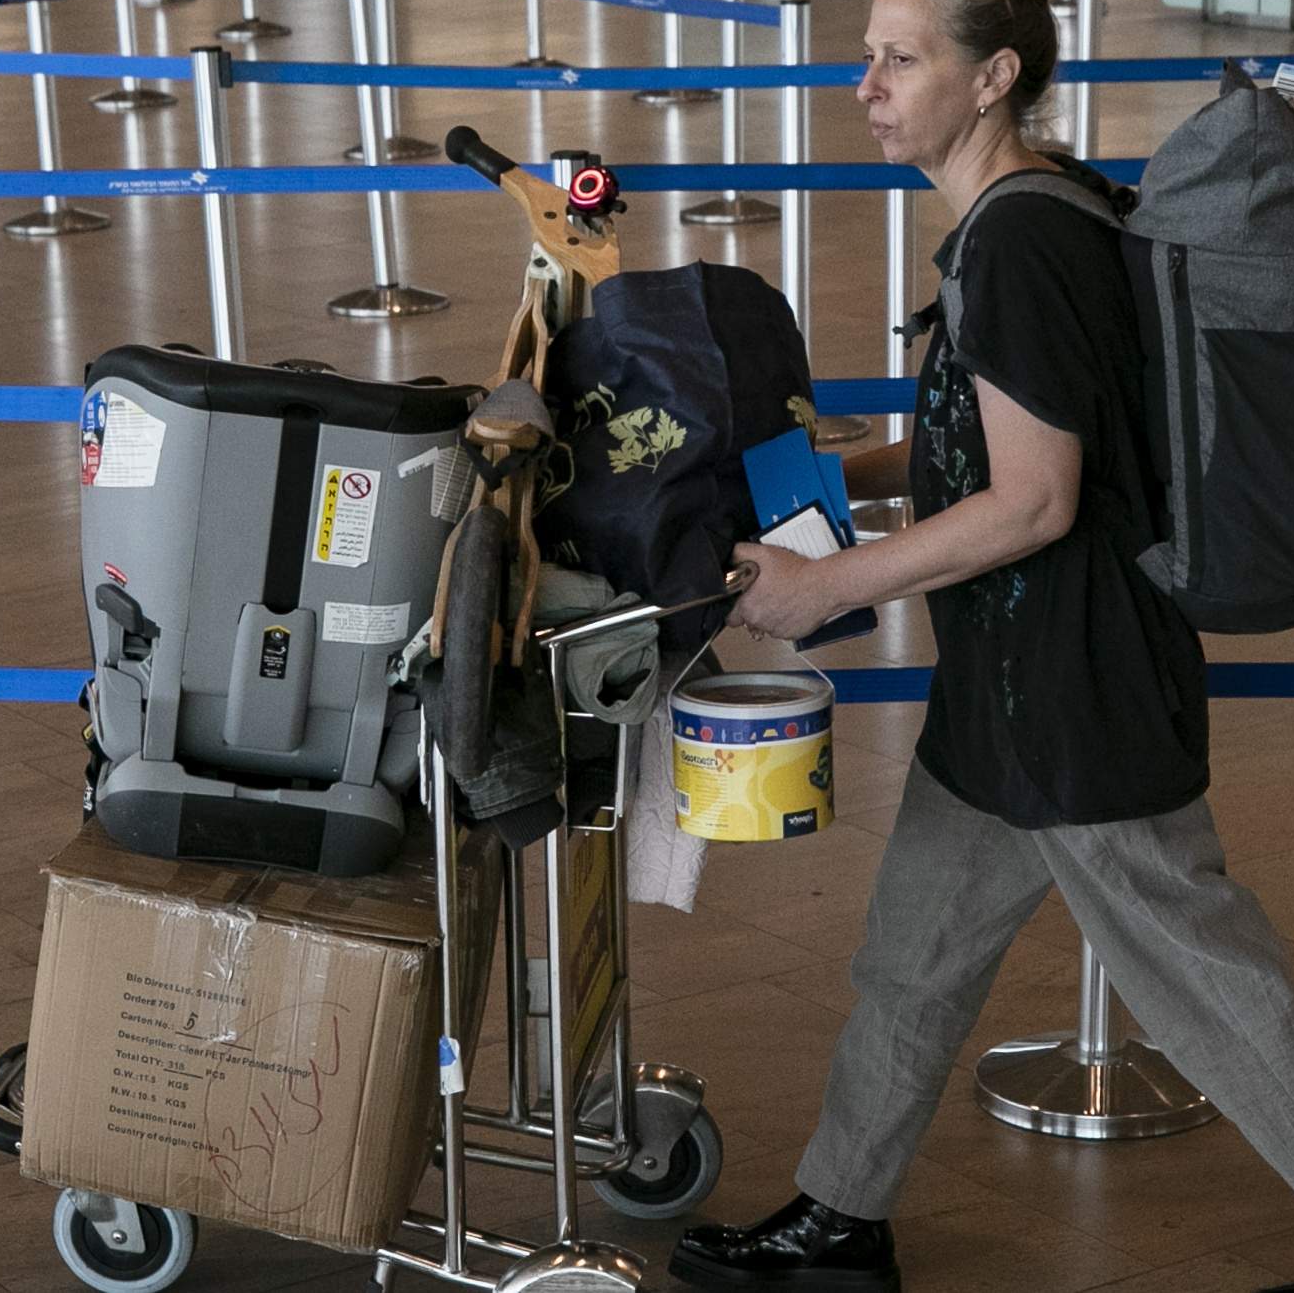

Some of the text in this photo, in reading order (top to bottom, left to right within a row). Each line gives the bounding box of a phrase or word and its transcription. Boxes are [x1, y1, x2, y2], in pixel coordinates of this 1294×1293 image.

[126, 972, 143, 985] Bio
[144, 977, 174, 992] Direct
[123, 992, 157, 1007] Order#
[121, 1011, 154, 1026] Carton
[116, 1049, 140, 1062] Total
[118, 1030, 177, 1050] Description:
[178, 1044, 204, 1057] Clear
[205, 1049, 225, 1063] PET
[226, 1054, 242, 1066] Jar
[168, 1079, 189, 1091] KGS
[165, 1097, 187, 1109] KGS
[109, 1105, 196, 1131] Destination: Israel
[107, 1123, 147, 1140] Country
[148, 1130, 158, 1140] of
[192, 1141, 219, 1154] China
